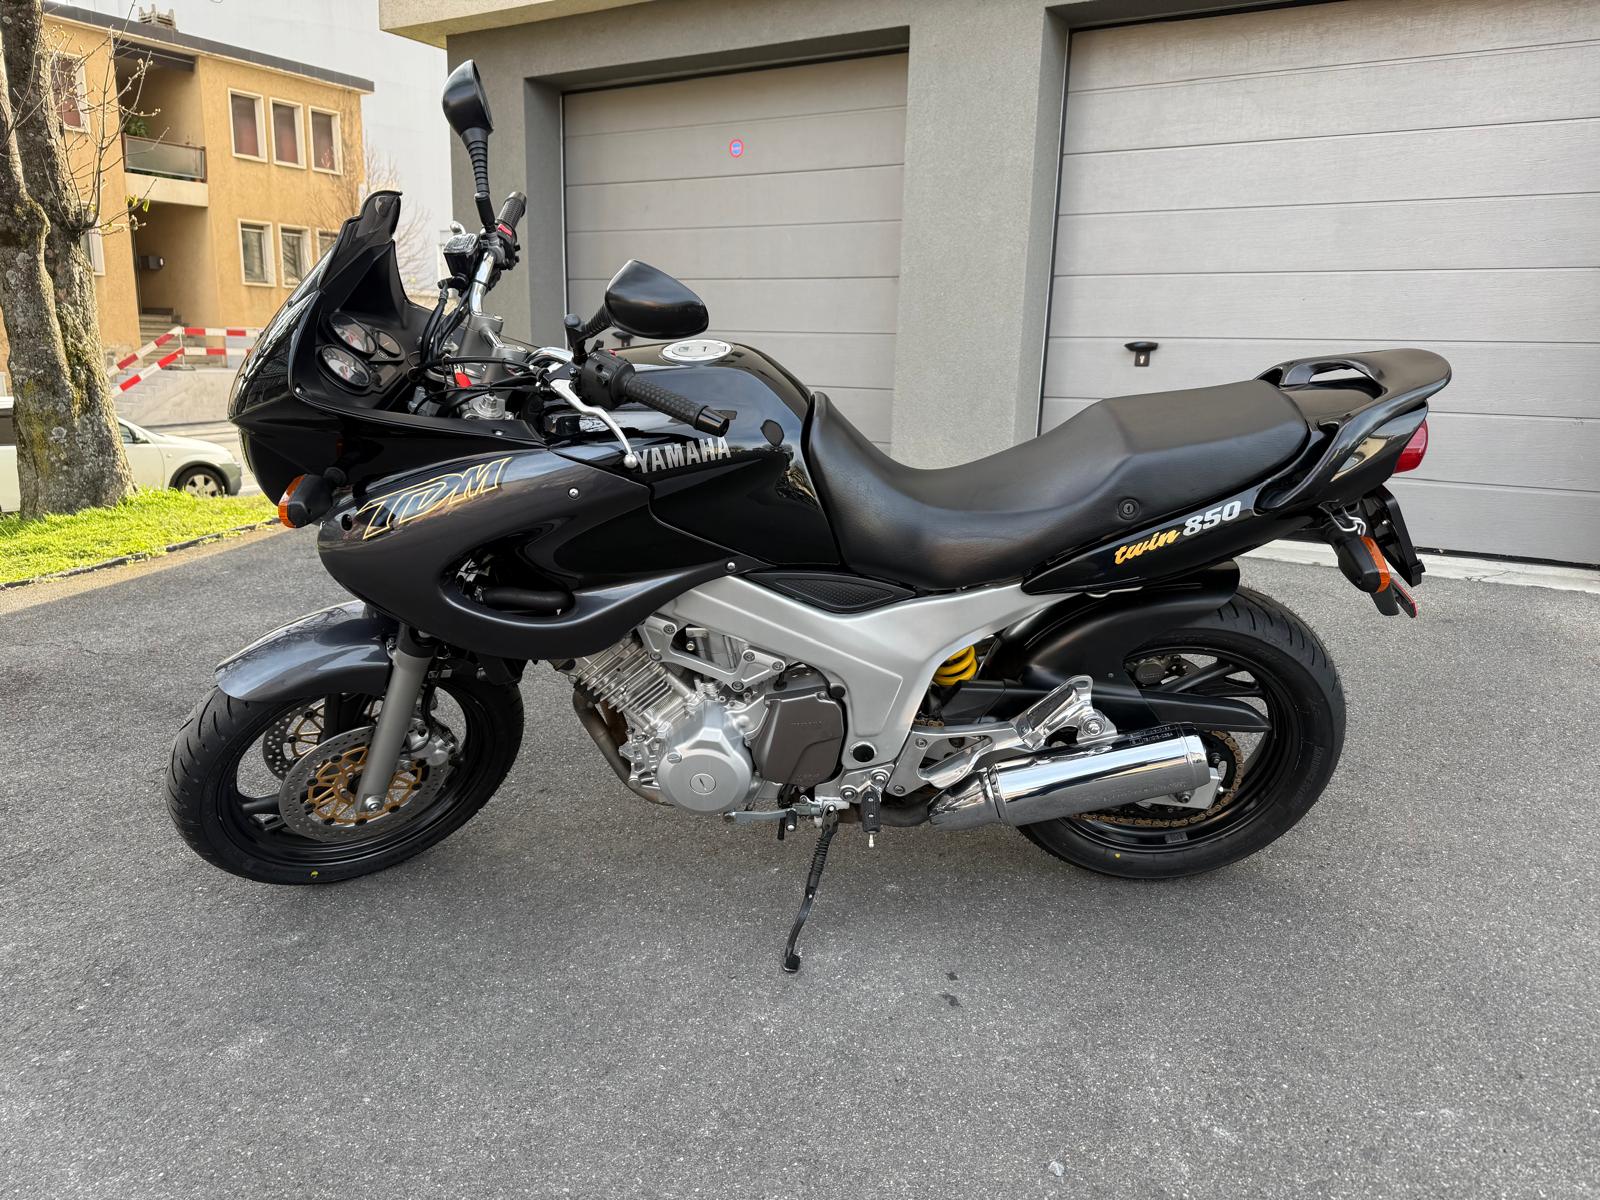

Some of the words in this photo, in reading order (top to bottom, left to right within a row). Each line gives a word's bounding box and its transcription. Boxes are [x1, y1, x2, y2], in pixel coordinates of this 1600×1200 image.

[634, 436, 731, 474] YAMAHA
[356, 456, 512, 540] TDM
[1114, 529, 1180, 565] twin
[1182, 500, 1241, 536] 850
